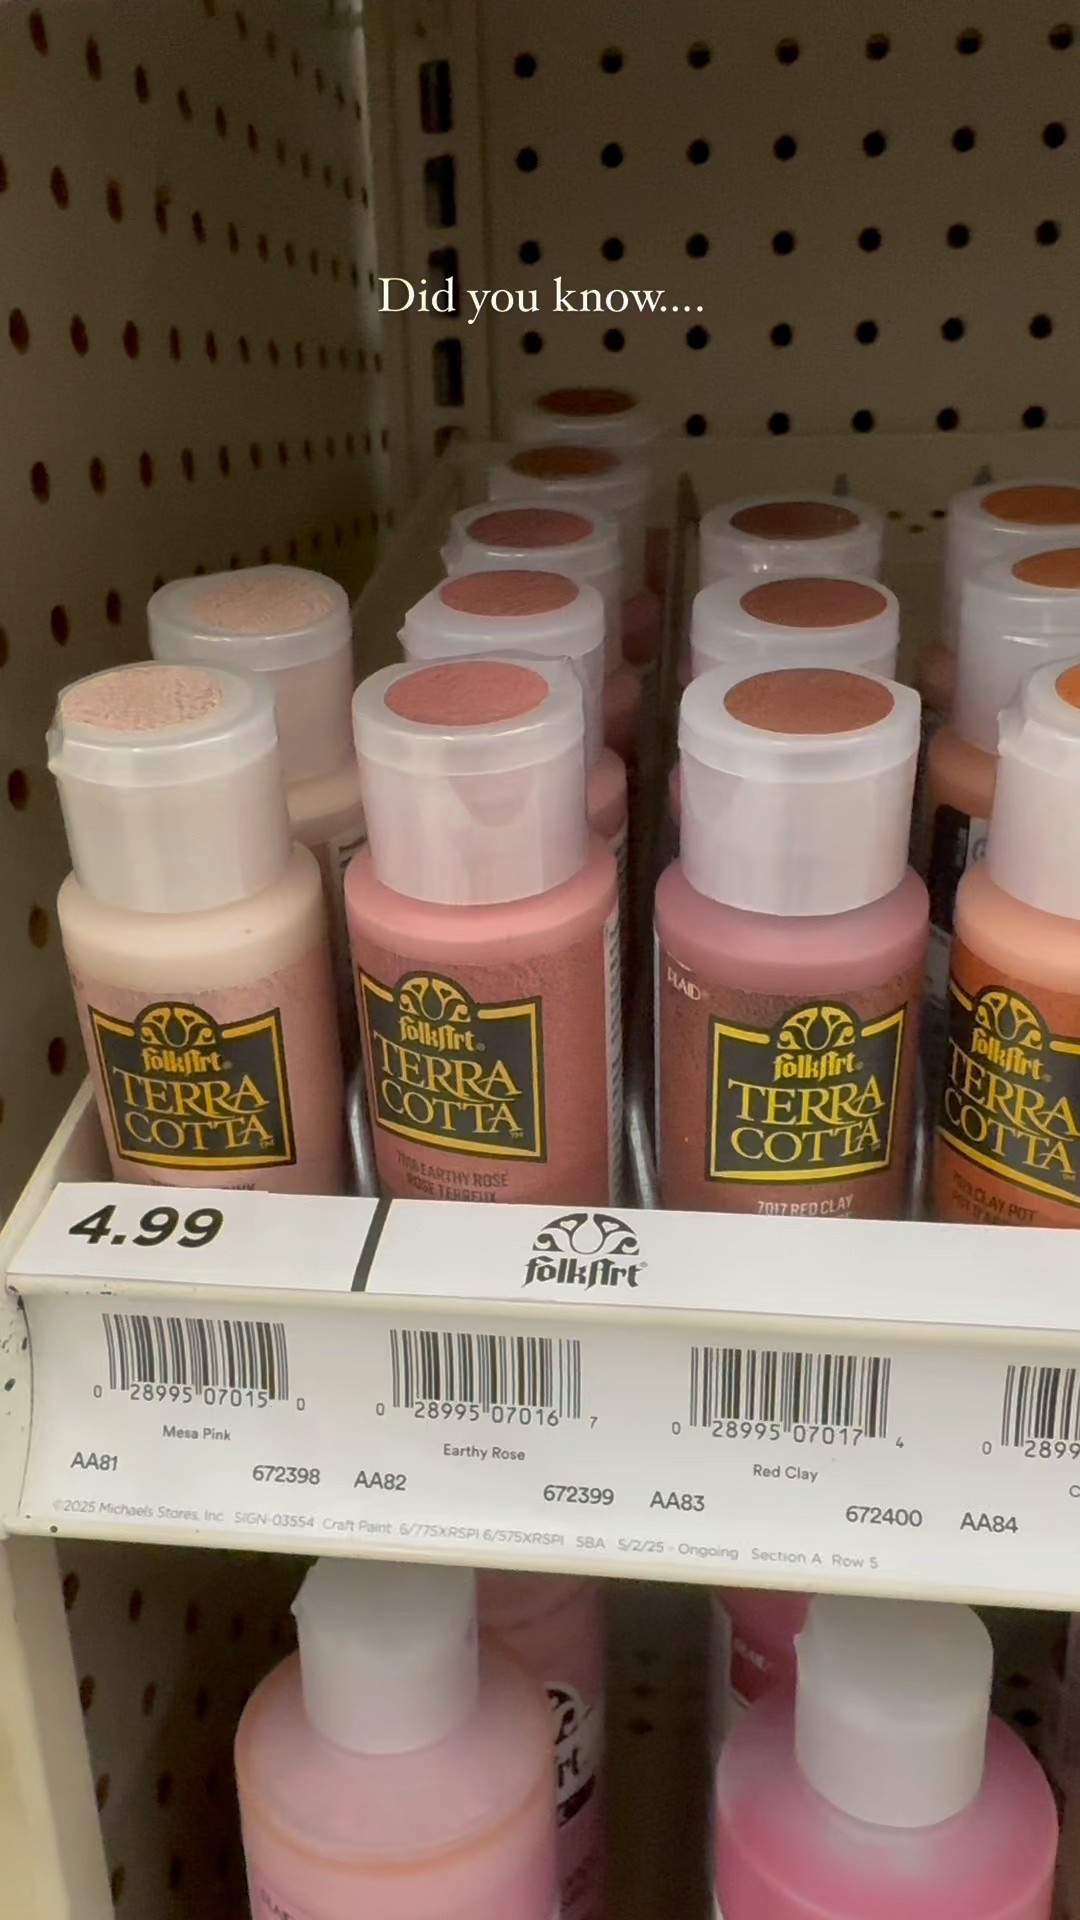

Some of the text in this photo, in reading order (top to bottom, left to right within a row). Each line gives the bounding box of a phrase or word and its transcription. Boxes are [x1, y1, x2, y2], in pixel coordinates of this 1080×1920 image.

[373, 1030, 522, 1103] TERRA
[113, 1066, 269, 1120] TERRA
[728, 1075, 885, 1126] TERRA
[949, 1036, 1080, 1142] TERRA
[382, 1079, 522, 1134] COTTA
[125, 1111, 273, 1150] COTTA
[731, 1117, 882, 1163] COTTA
[945, 1088, 1076, 1174] COTTA
[420, 1163, 472, 1186] EARTHY
[473, 1172, 509, 1188] ROSE
[757, 1193, 854, 1216] 7017 RED CLAY
[1008, 1203, 1037, 1221] POT
[68, 1204, 224, 1248] 4.99
[93, 1384, 306, 1411] 0 28995 07015 0
[376, 1401, 598, 1429] 0 28995 07016 7
[162, 1425, 231, 1441] Mesa Pink
[671, 1420, 904, 1449] 0 28995 07017 4
[70, 1451, 118, 1471] AA81
[443, 1443, 525, 1461] Earthy Rose
[982, 1440, 1080, 1459] 0 2899
[252, 1464, 321, 1485] 672398
[353, 1470, 408, 1491] AA82
[753, 1464, 818, 1483] Red Clay
[543, 1484, 615, 1505] 672399
[650, 1491, 705, 1512] AA83
[845, 1505, 923, 1527] 672400
[960, 1512, 1018, 1533] AA84
[100, 1502, 154, 1518] Michaels
[322, 1516, 354, 1532] Craft
[358, 1520, 392, 1535] Paint
[576, 1535, 606, 1549] SBA
[618, 1538, 664, 1553] 5/2/25
[678, 1543, 739, 1560] Ongoing
[751, 1547, 806, 1563] Section
[811, 1552, 822, 1565] A
[832, 1553, 865, 1569] Row
